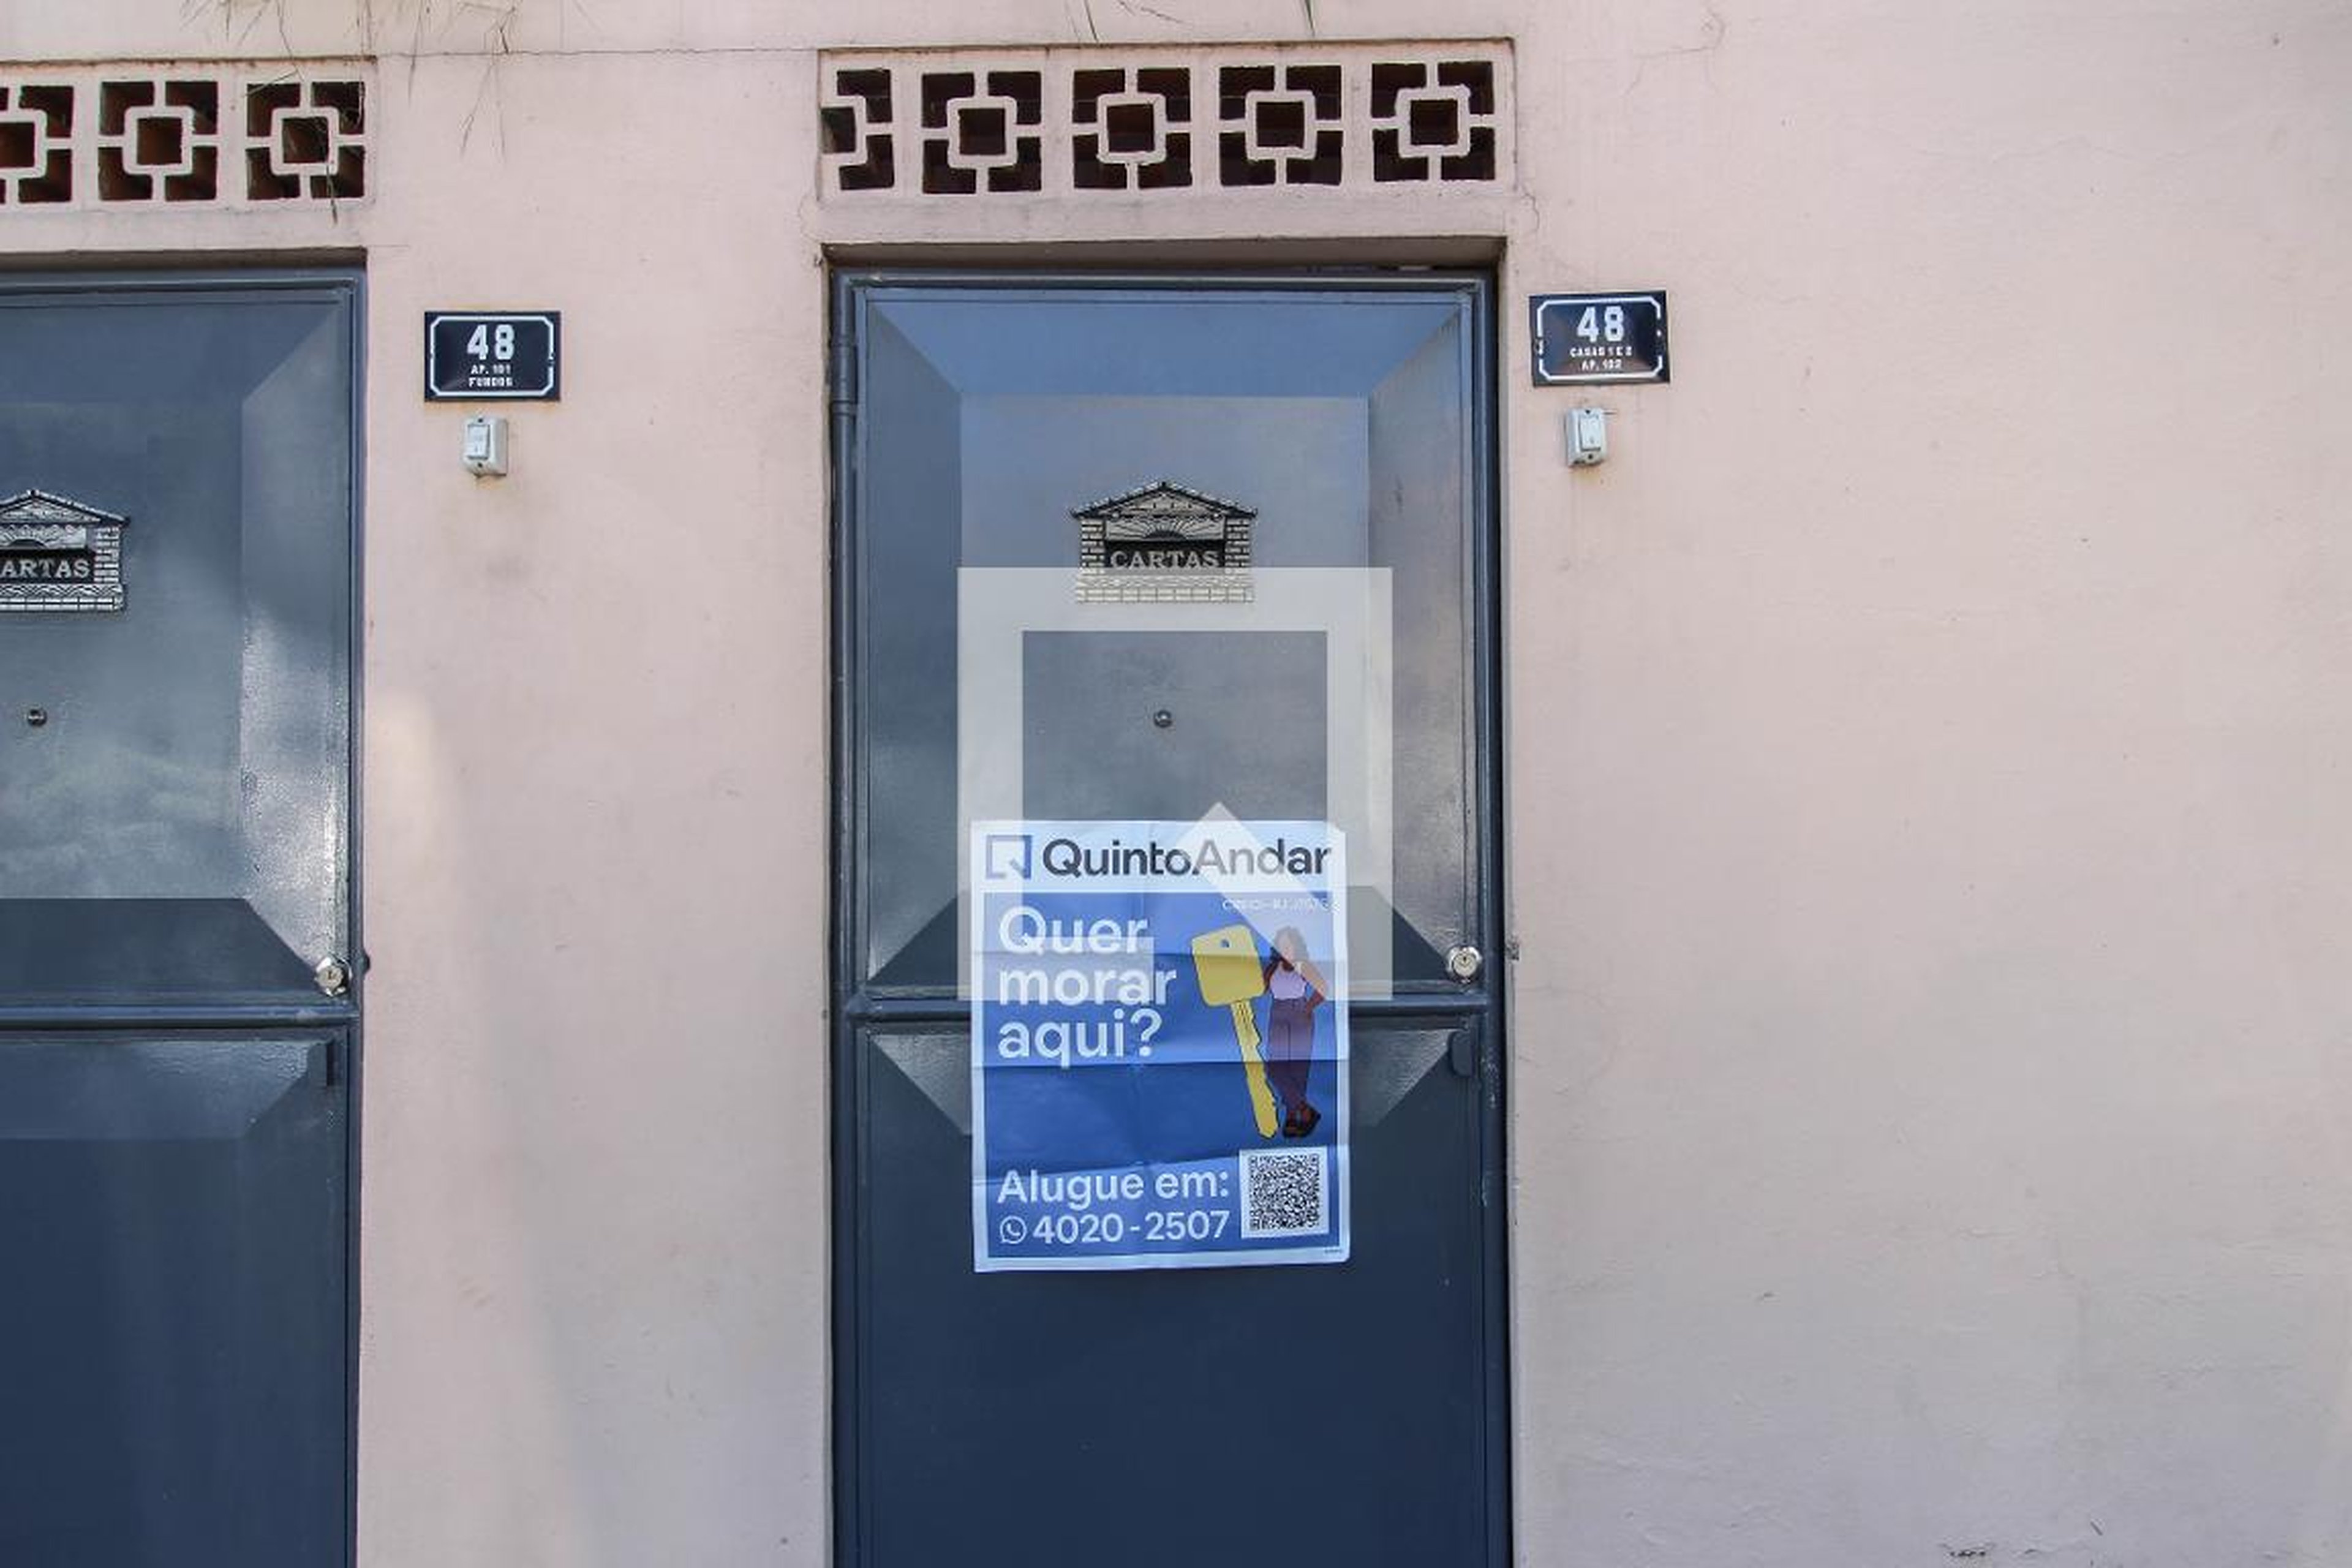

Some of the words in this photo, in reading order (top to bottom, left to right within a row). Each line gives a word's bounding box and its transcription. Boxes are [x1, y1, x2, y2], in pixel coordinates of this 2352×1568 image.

[467, 324, 514, 360] 48
[1577, 306, 1623, 342] 48
[470, 364, 489, 374] AP.
[0, 559, 90, 578] ARTAS
[1110, 551, 1219, 568] CARTAS
[1042, 839, 1331, 878] QuintoAndar
[999, 906, 1148, 955] Quer
[998, 966, 1177, 1006] morar
[998, 1008, 1163, 1069] aqui?
[997, 1169, 1144, 1210] Alugue
[1155, 1170, 1229, 1199] em:
